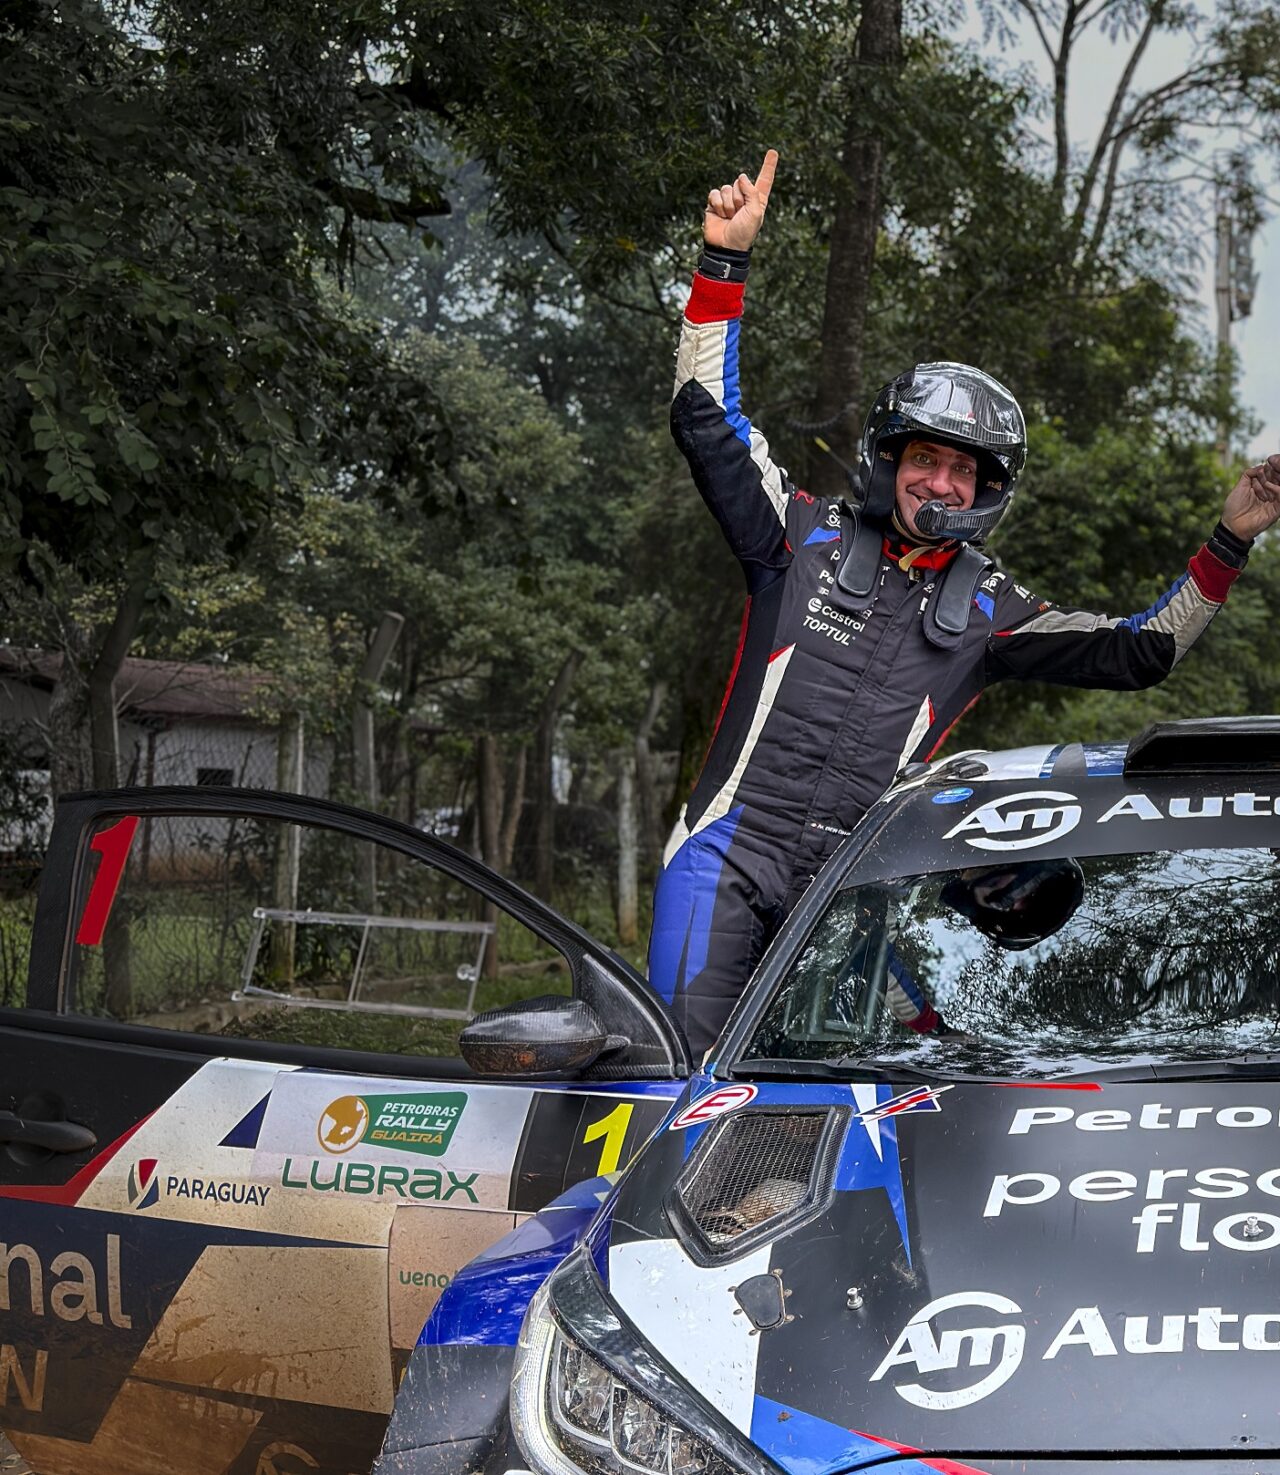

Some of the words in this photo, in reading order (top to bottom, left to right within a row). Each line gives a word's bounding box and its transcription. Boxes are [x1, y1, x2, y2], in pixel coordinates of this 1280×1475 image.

[803, 615, 851, 646] TOPTUL
[821, 605, 866, 633] Castrol
[76, 816, 140, 946] 1
[375, 1114, 452, 1131] RALLY
[382, 1102, 459, 1118] PETROBRAS
[371, 1129, 443, 1145] GUAIRÁ
[583, 1102, 635, 1177] 1
[166, 1175, 271, 1208] PARAGUAY
[0, 1233, 132, 1330] nal
[400, 1270, 450, 1288] ueno
